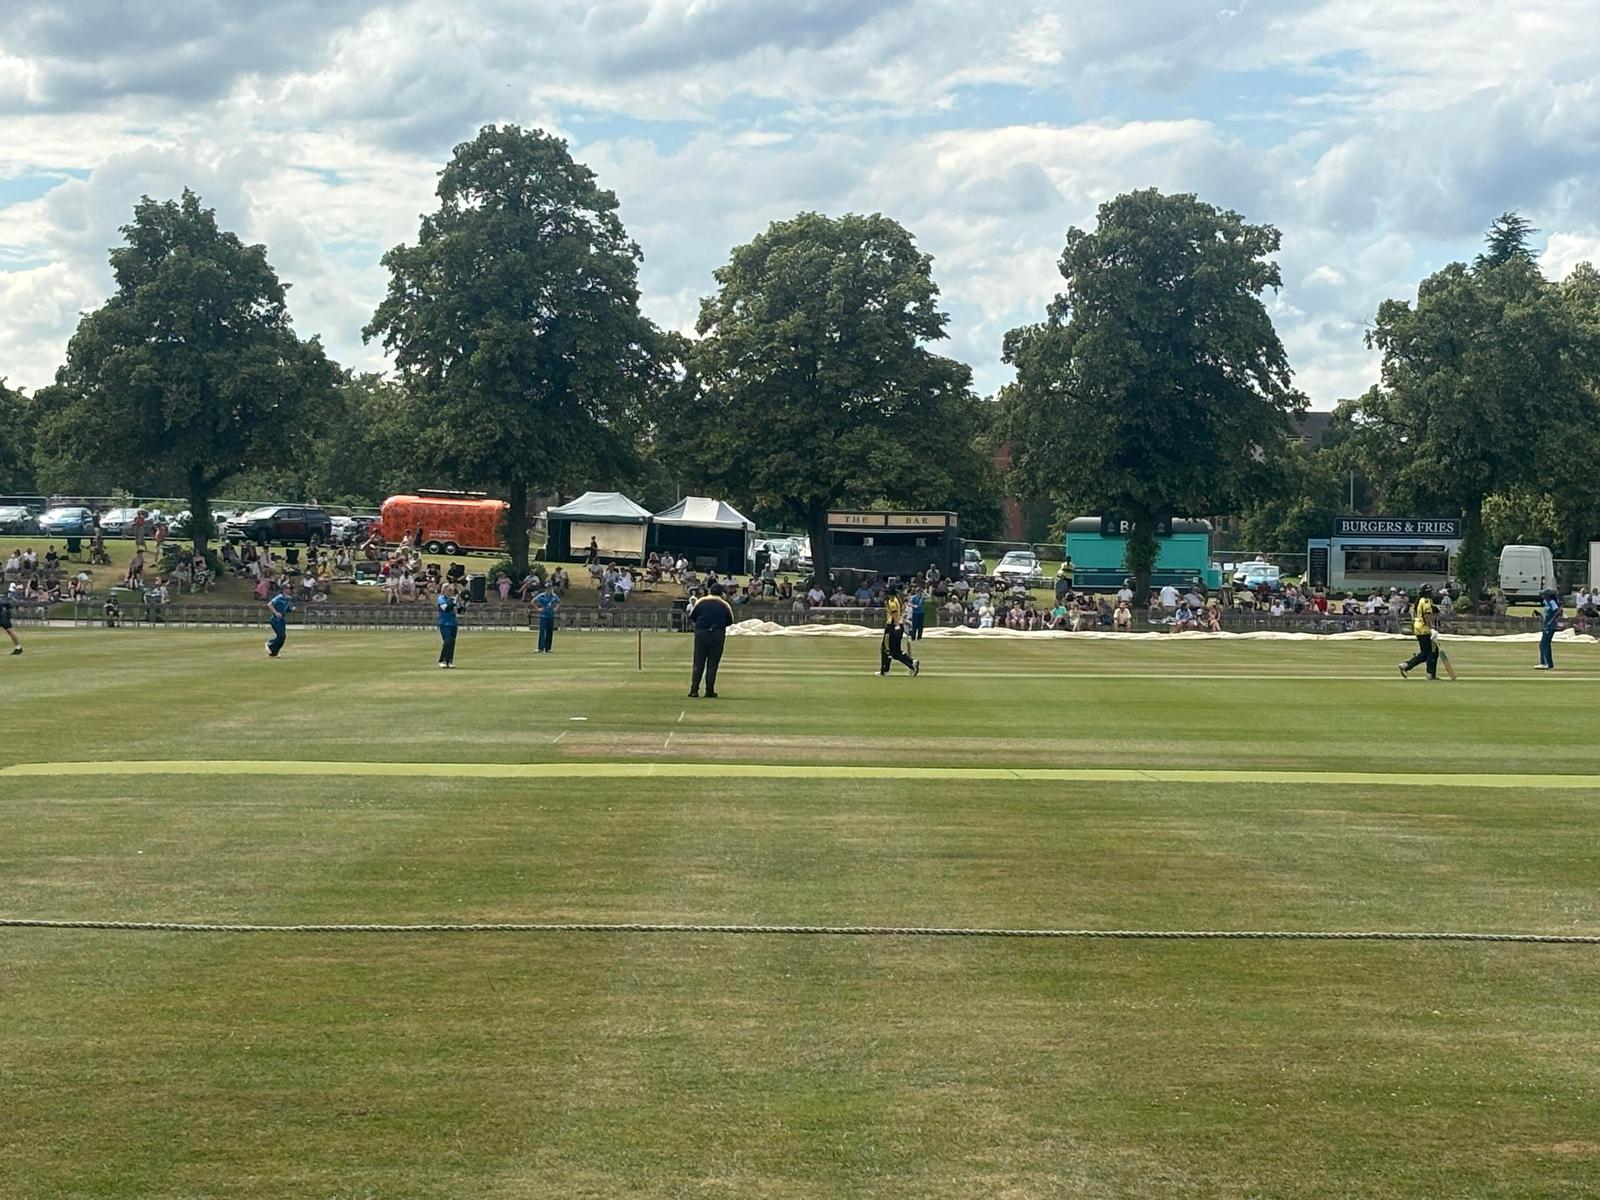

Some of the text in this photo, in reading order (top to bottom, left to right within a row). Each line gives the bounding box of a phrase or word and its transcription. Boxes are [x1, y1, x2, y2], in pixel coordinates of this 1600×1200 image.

[845, 516, 928, 525] THE BAR
[1341, 520, 1455, 533] BURGERS & FRIES
